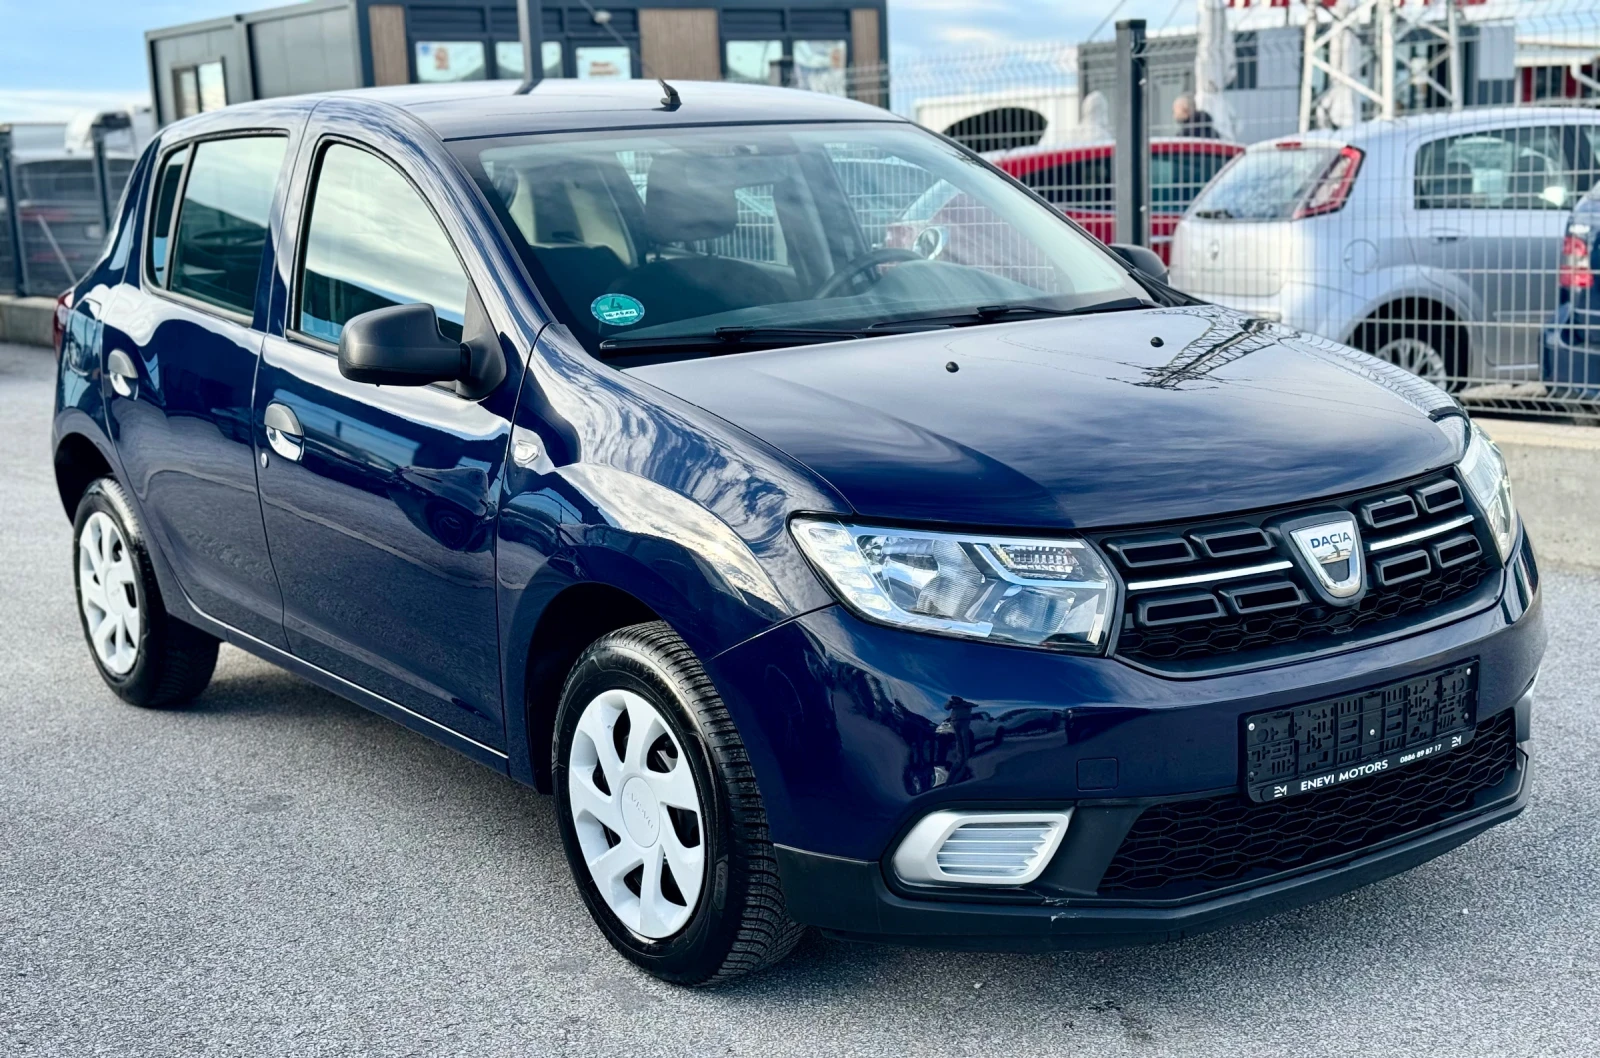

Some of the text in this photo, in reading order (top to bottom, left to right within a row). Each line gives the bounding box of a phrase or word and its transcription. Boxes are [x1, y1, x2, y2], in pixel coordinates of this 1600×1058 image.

[1310, 531, 1352, 549] DACIA
[1300, 773, 1335, 791] ENEVI
[1338, 759, 1389, 782] MOTORS
[1400, 752, 1416, 764] 0886
[1416, 749, 1425, 758] 89
[1425, 746, 1433, 755] 87
[1434, 743, 1442, 752] 17
